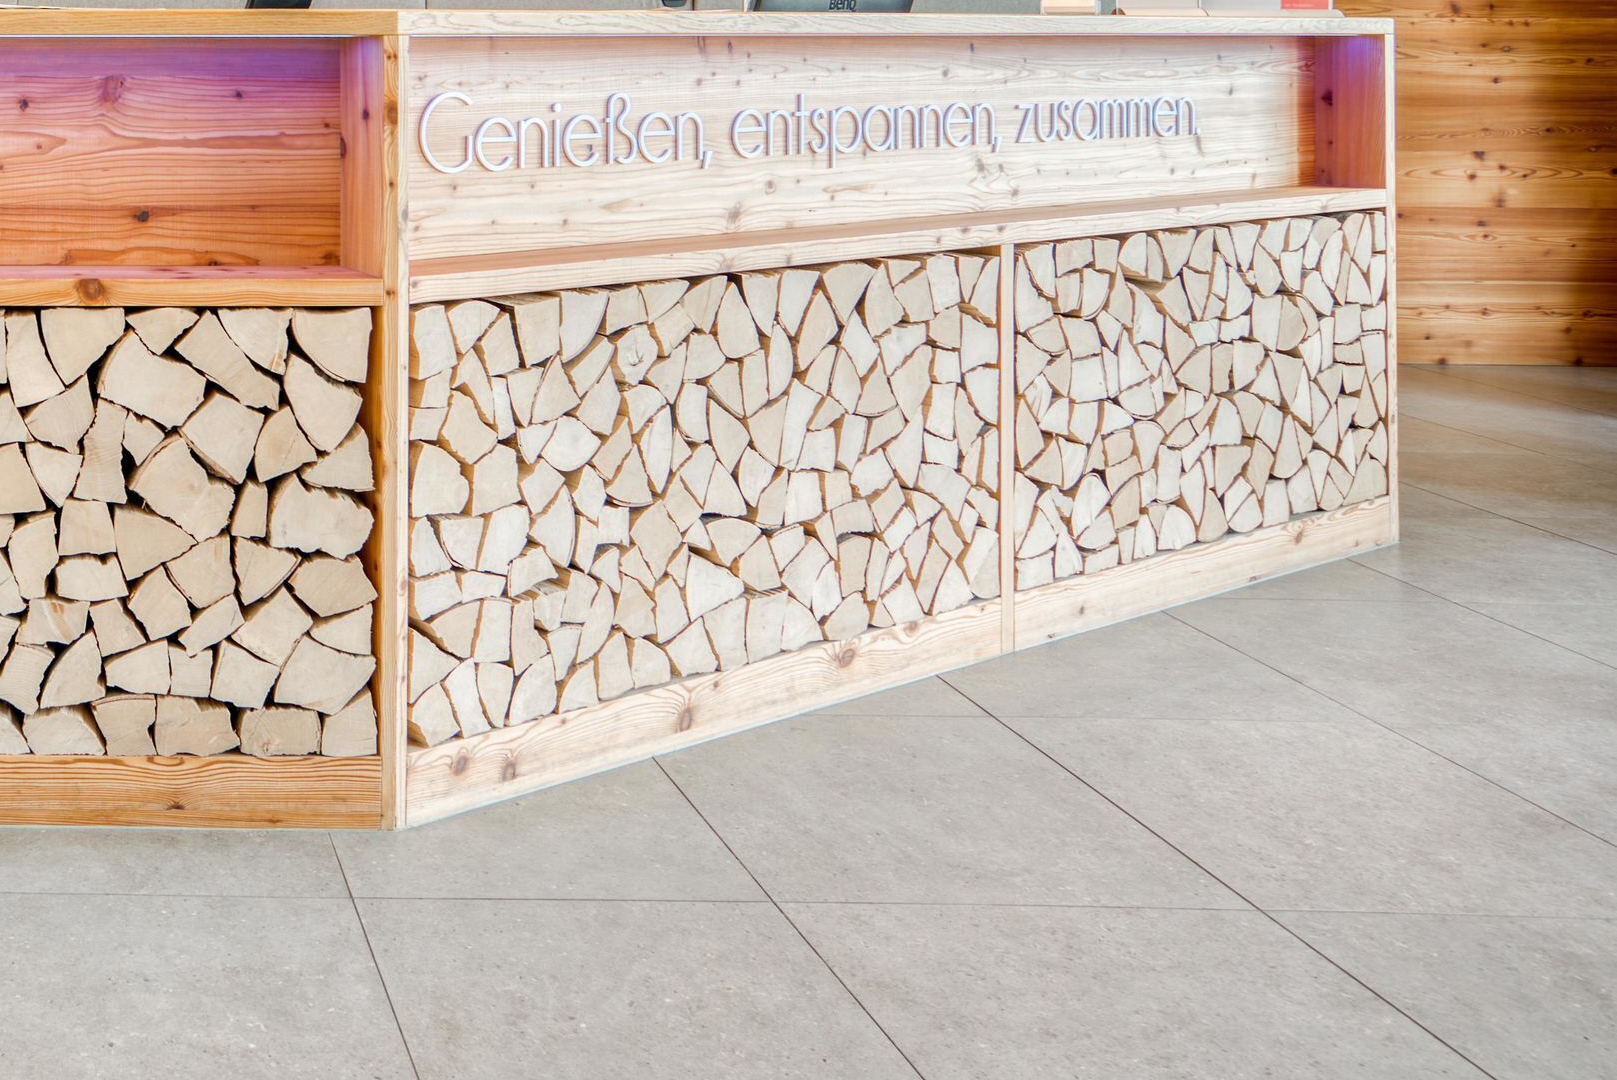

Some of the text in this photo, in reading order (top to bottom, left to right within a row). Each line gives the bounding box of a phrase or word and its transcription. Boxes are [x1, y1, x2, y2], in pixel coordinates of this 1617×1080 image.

[417, 91, 1201, 175] Genießen, entspannen, zusammen.
